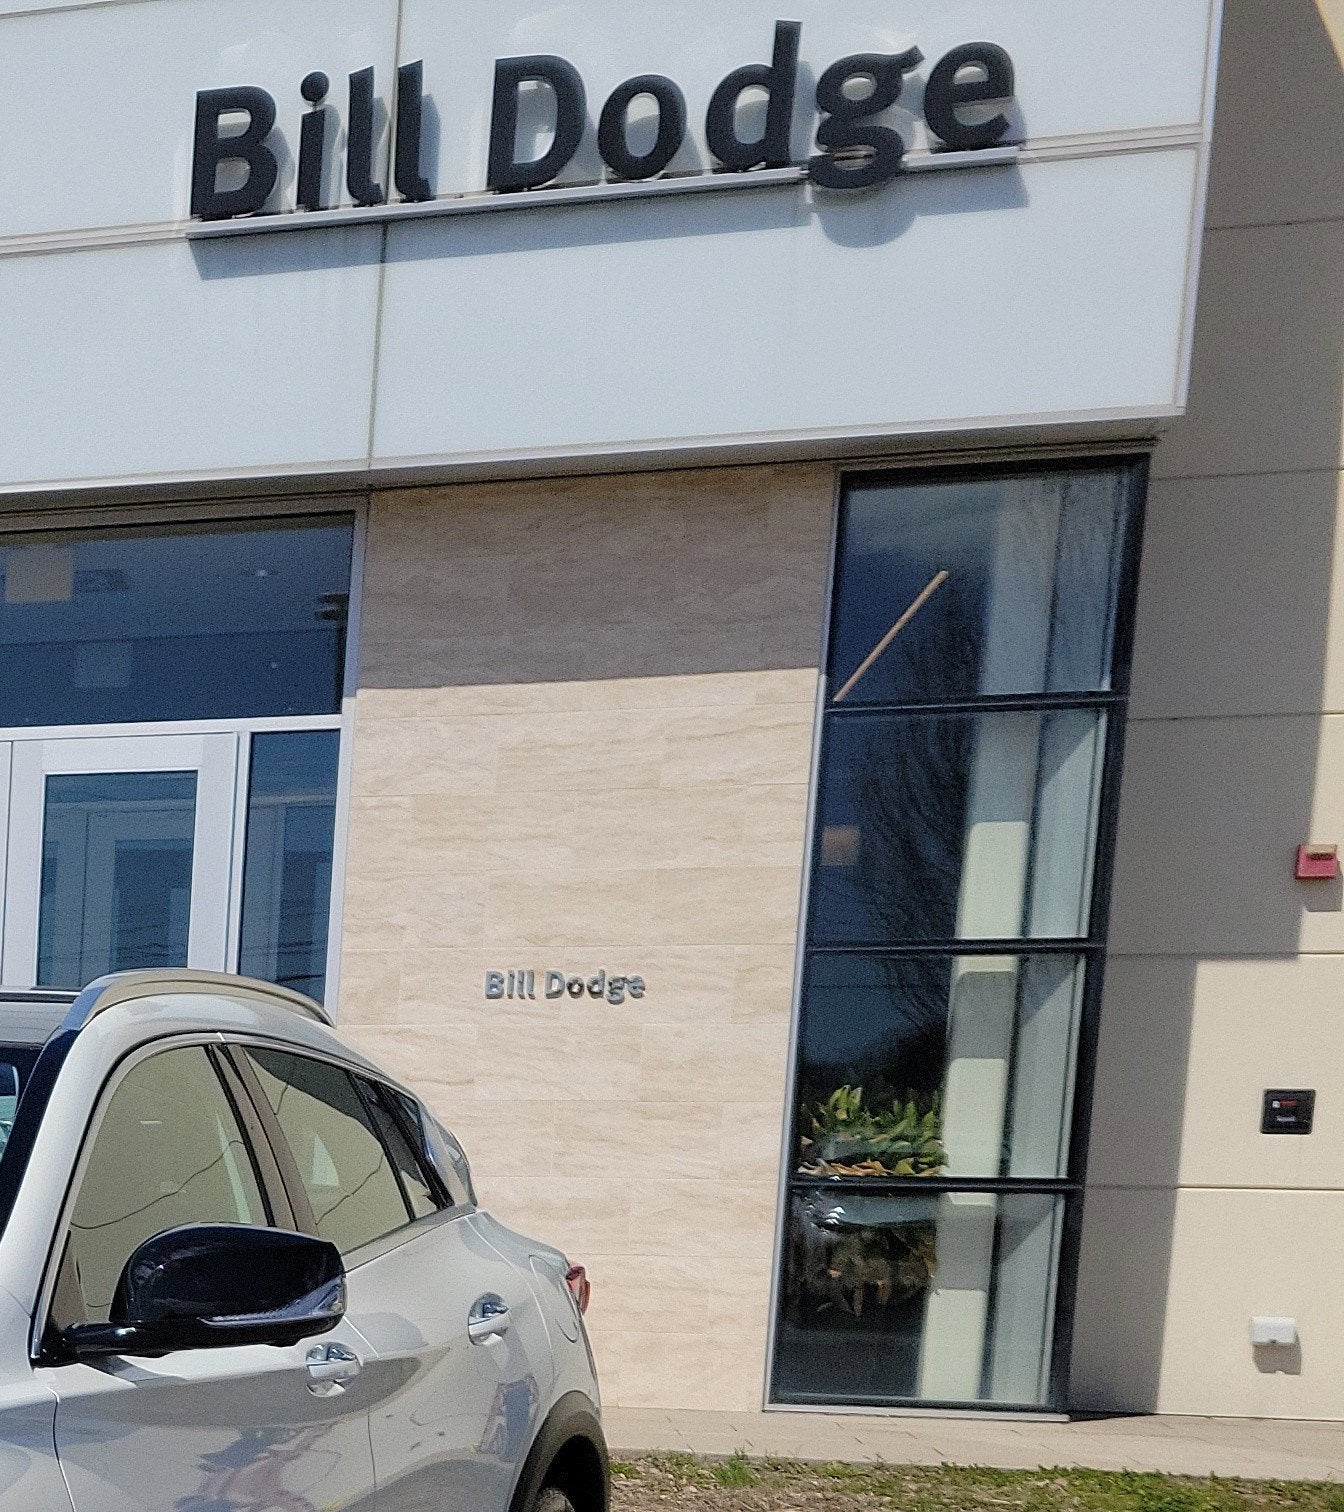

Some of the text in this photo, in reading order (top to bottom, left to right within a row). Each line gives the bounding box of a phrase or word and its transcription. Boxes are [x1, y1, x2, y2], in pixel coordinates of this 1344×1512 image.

[192, 19, 1018, 221] Bill Dodge
[485, 969, 646, 1005] Bill Dodge
